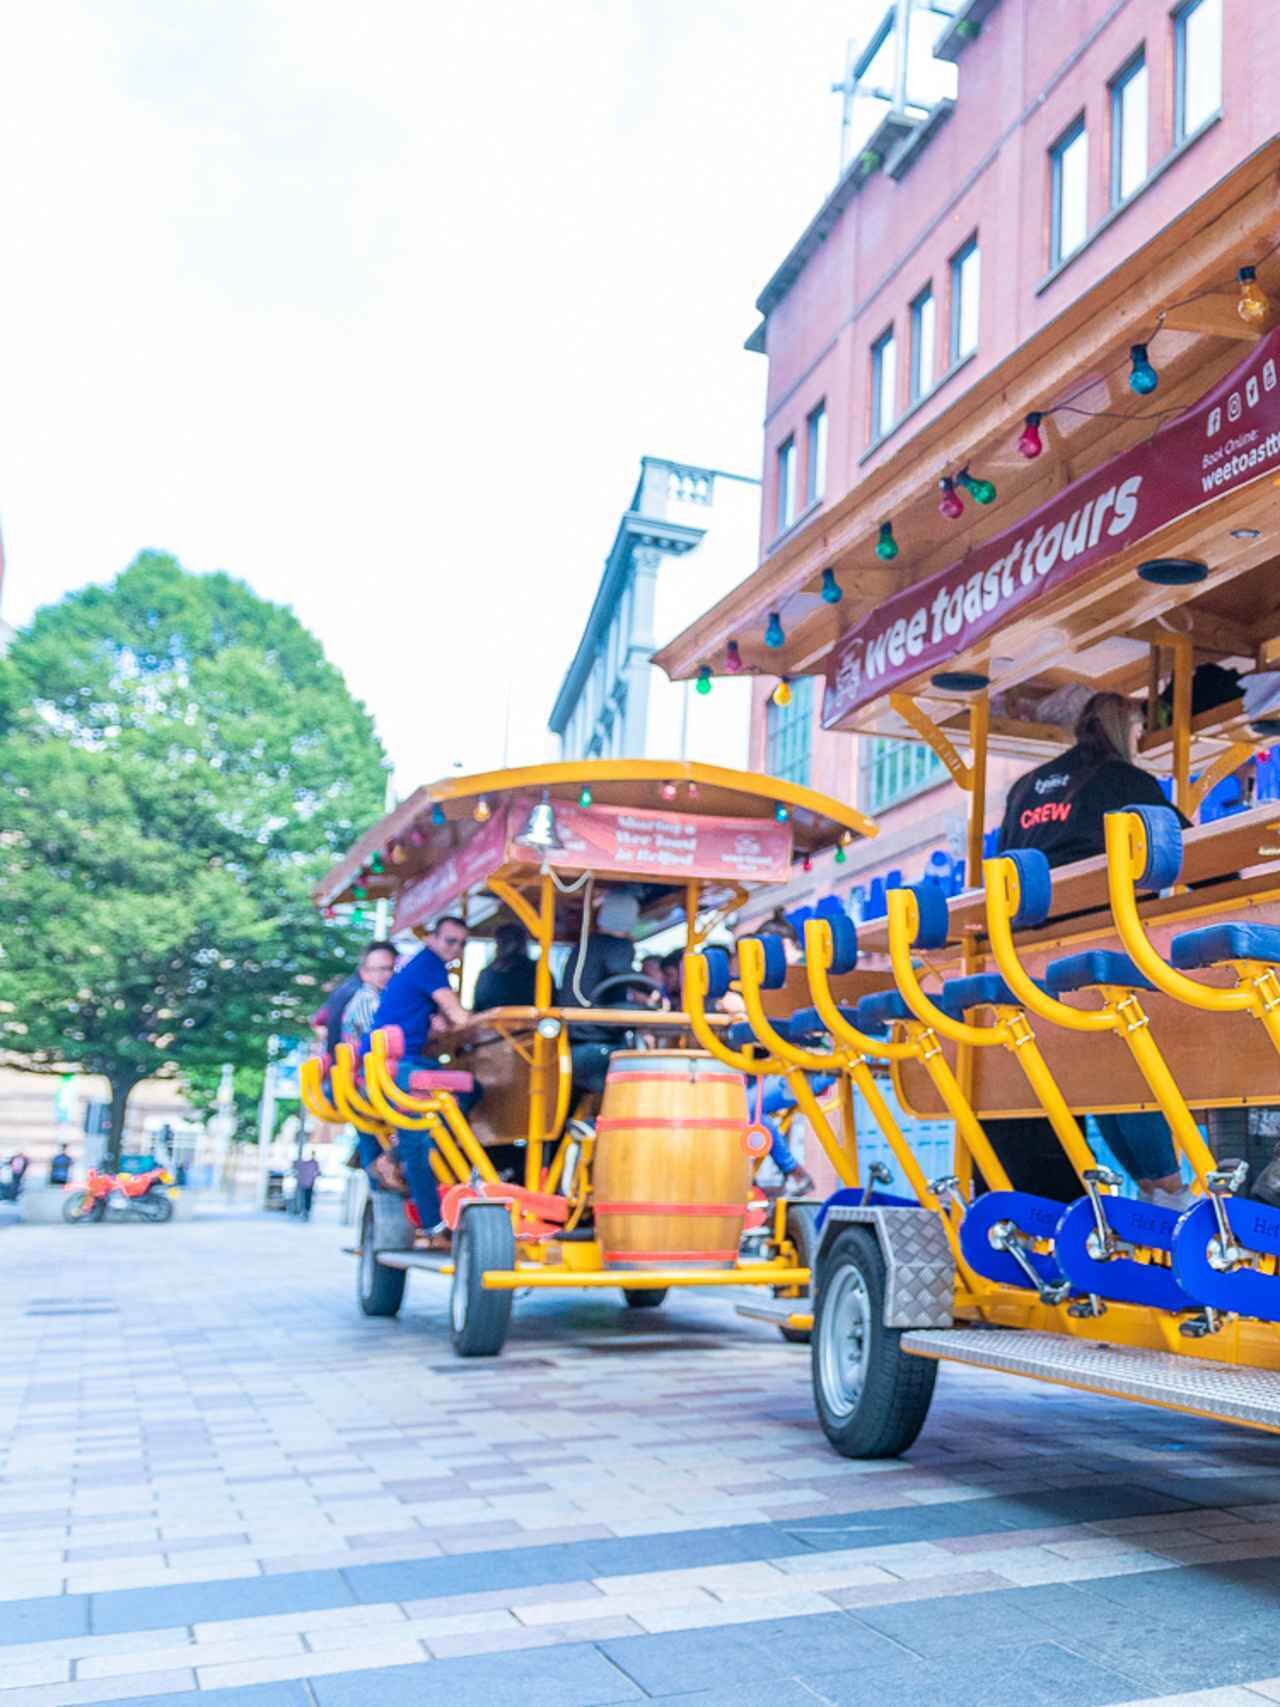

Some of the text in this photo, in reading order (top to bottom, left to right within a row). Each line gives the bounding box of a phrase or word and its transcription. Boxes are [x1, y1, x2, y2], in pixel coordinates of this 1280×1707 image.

[865, 475, 1143, 681] wee toast tours
[1020, 802, 1072, 830] CREW
[1253, 1216, 1280, 1238] Het
